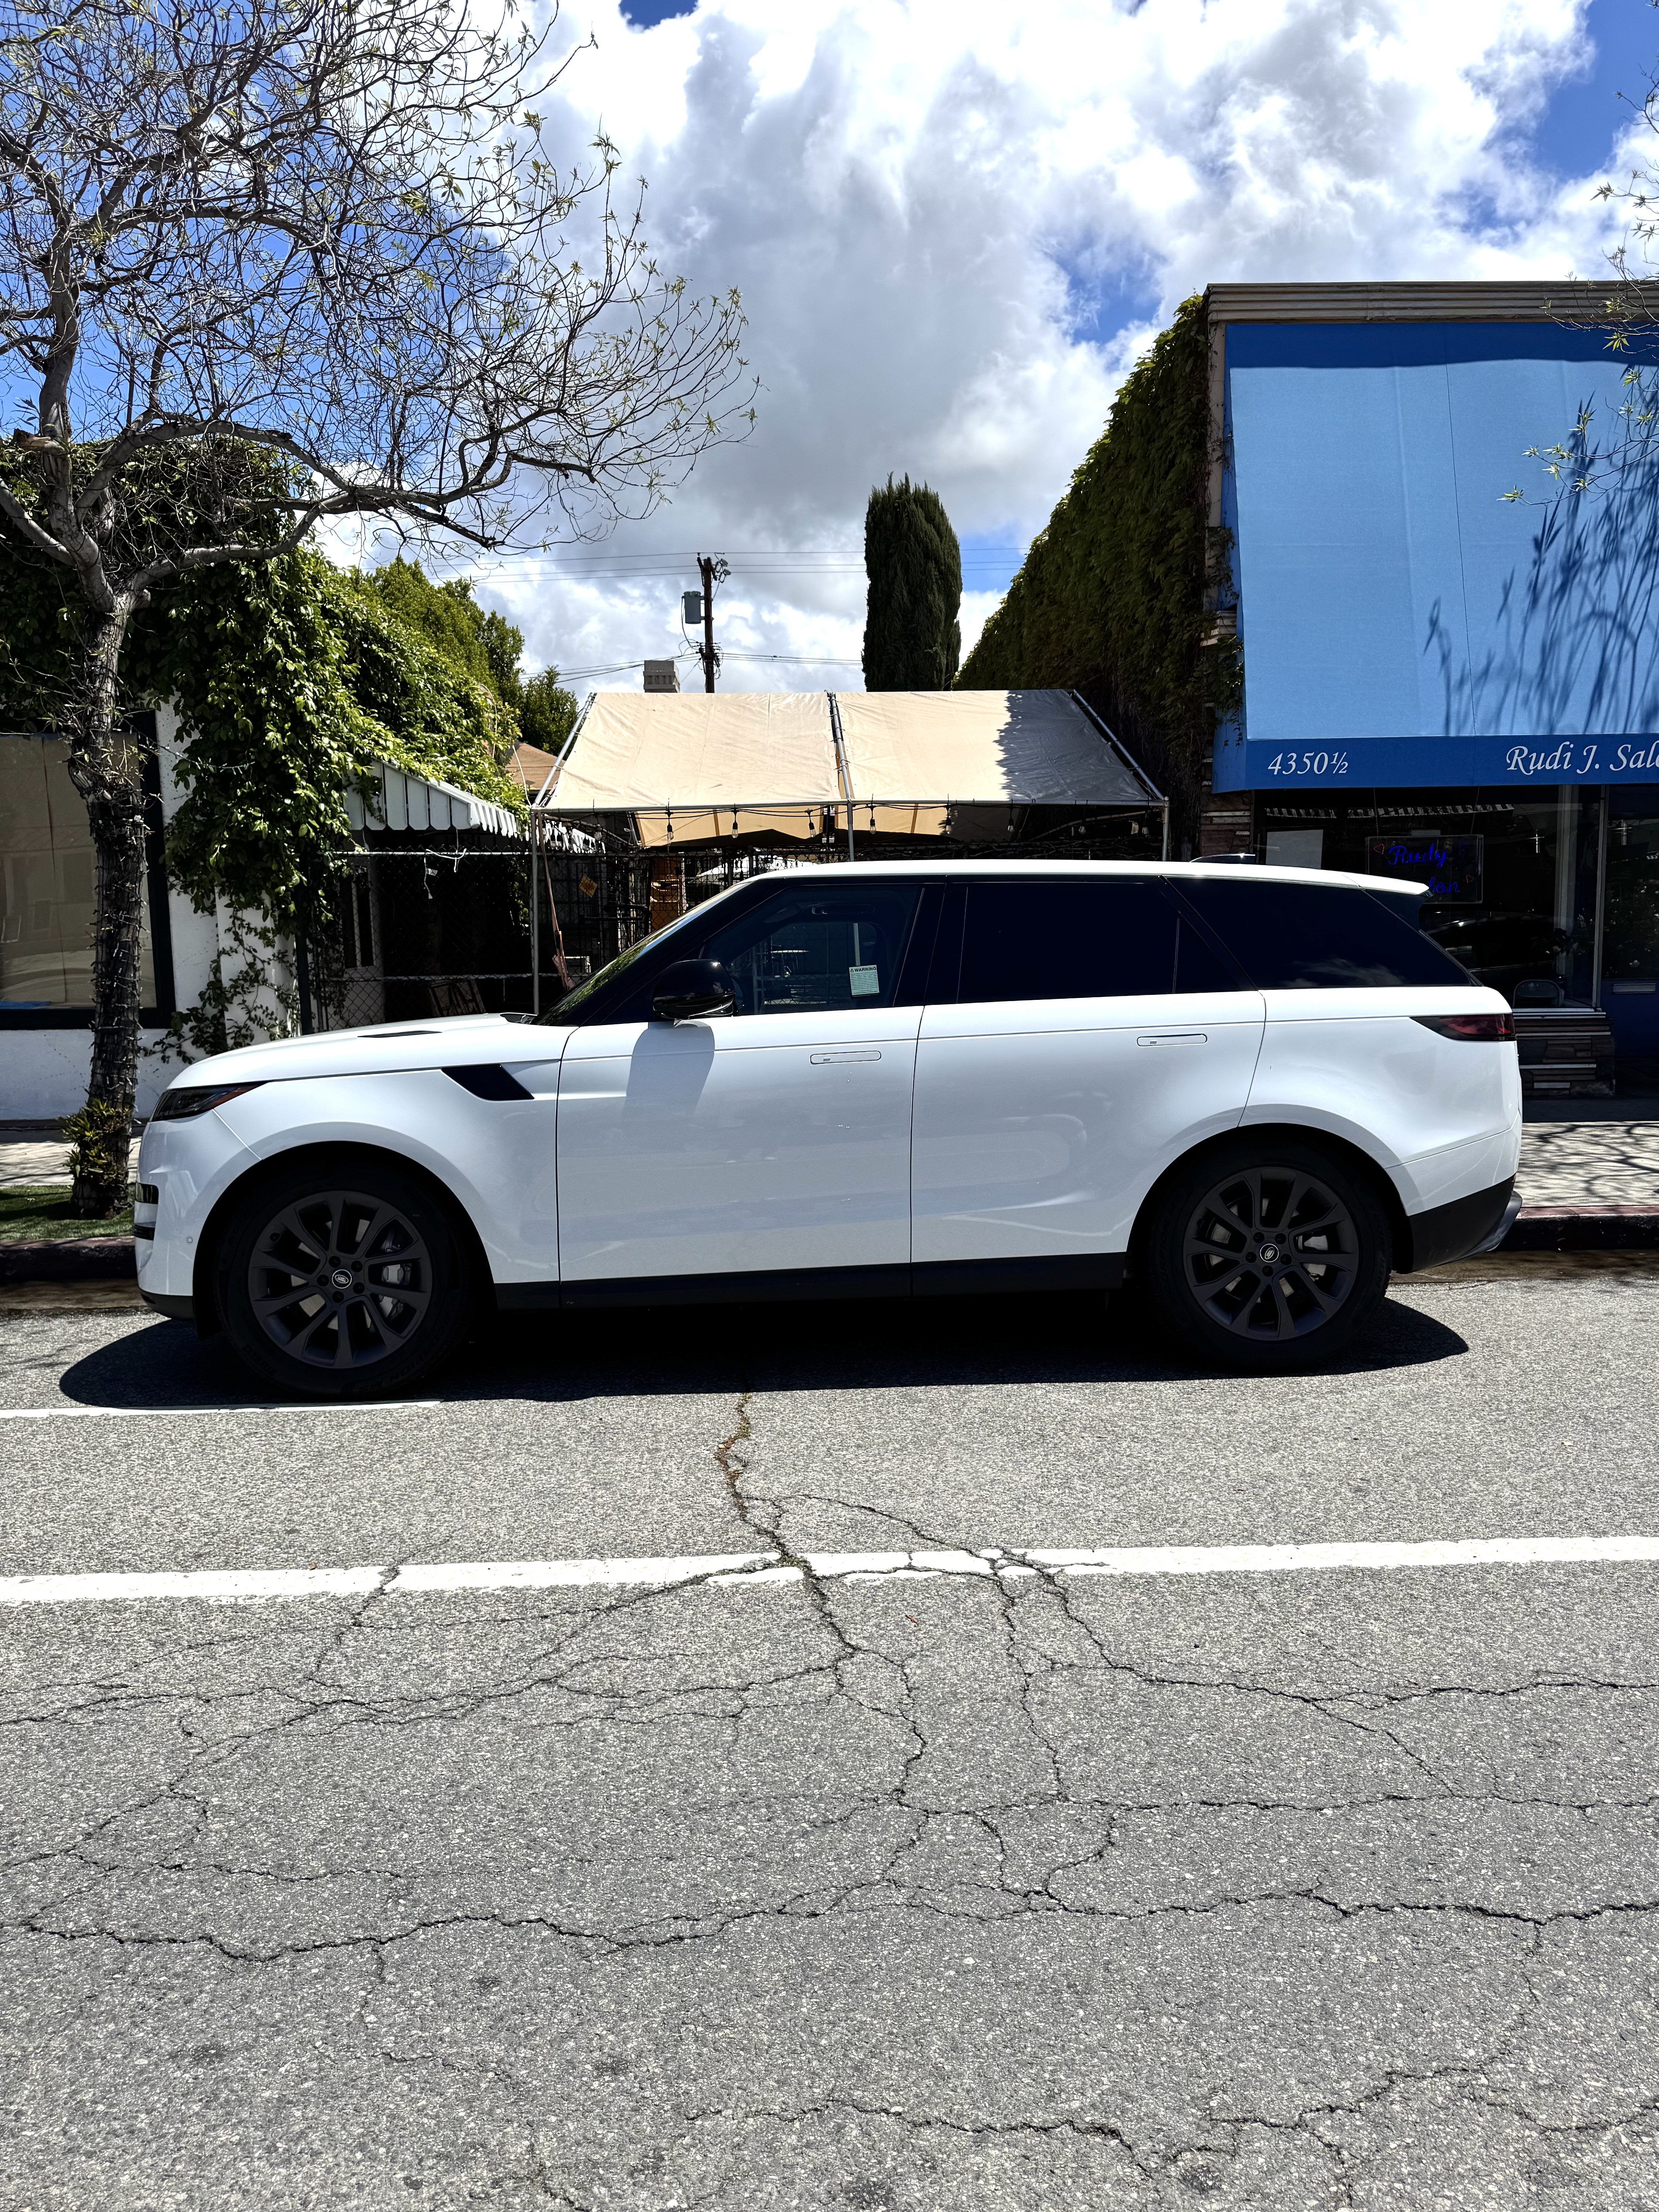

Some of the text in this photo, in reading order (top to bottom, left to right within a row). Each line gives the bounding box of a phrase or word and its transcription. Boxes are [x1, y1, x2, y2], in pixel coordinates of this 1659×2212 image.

[1506, 740, 1659, 775] Rudi J. Sal
[1388, 843, 1448, 869] Rudy
